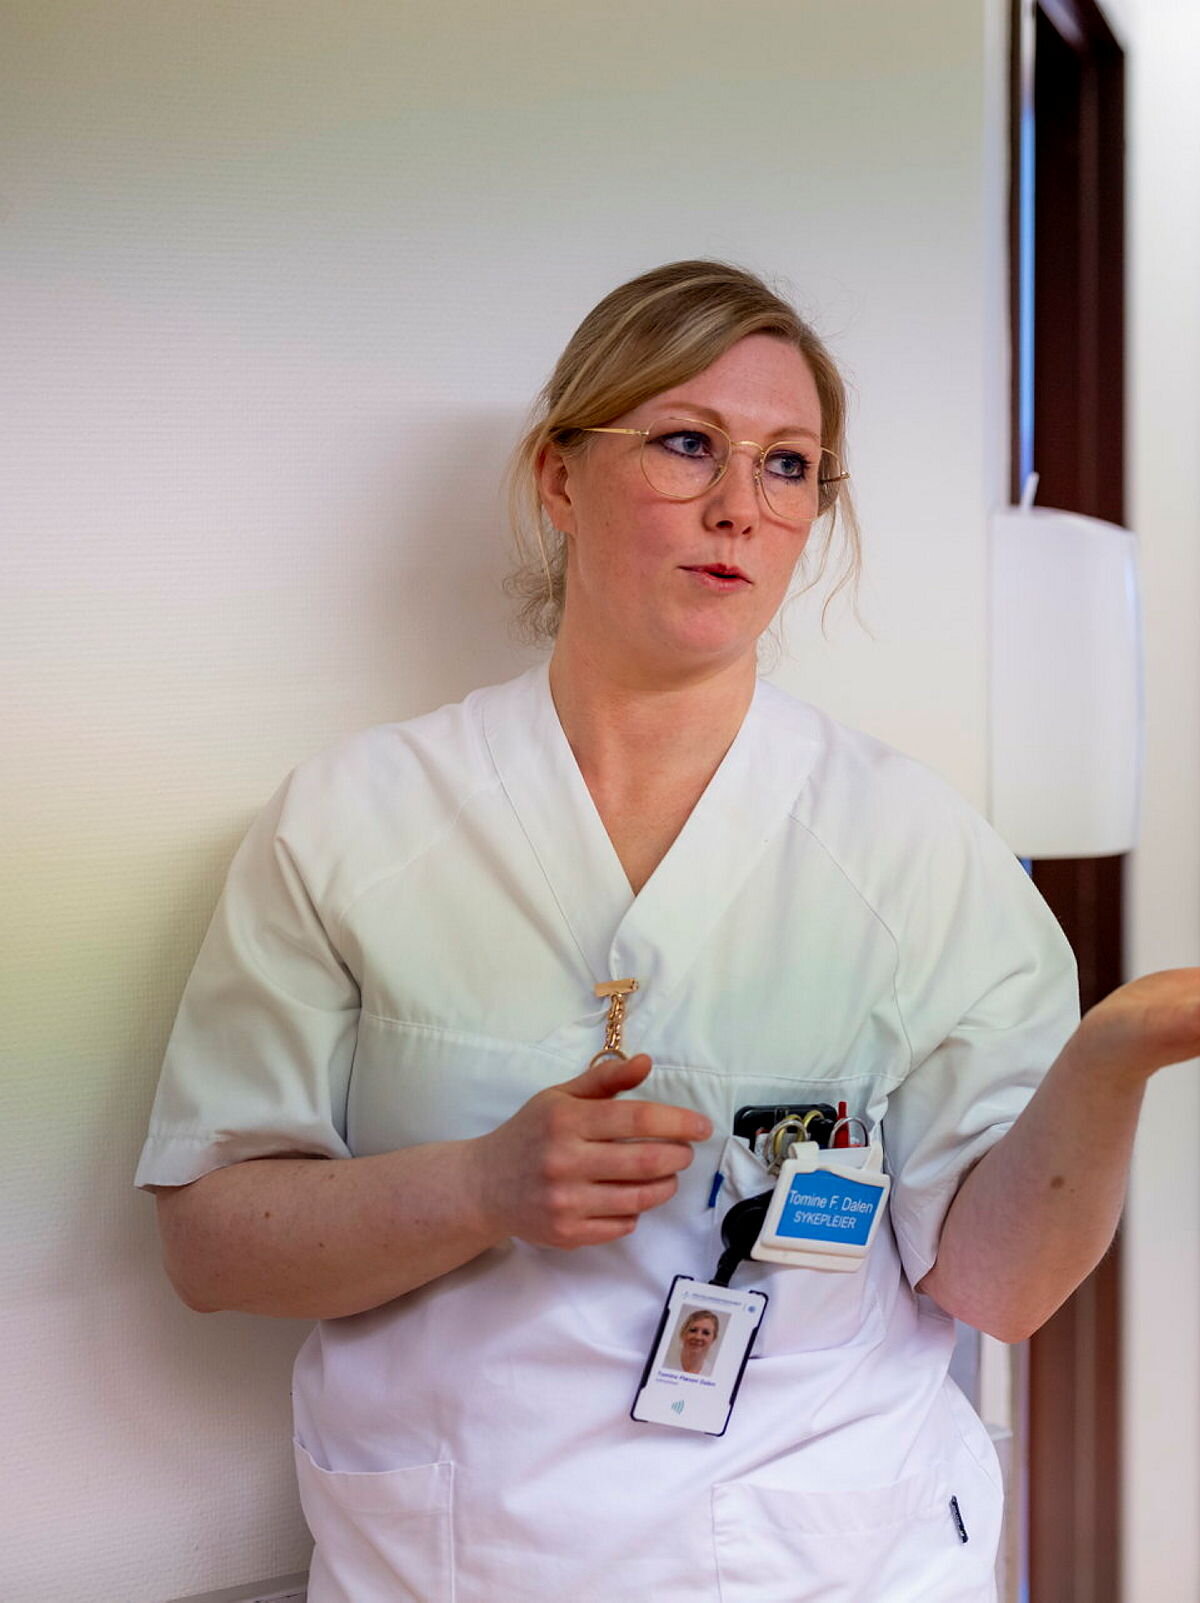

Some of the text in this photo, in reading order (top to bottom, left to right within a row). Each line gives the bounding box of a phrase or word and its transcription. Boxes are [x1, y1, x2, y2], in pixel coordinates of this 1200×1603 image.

[789, 1190, 874, 1214] Tomine F. Dalen
[793, 1211, 857, 1229] SYKEPLEIER
